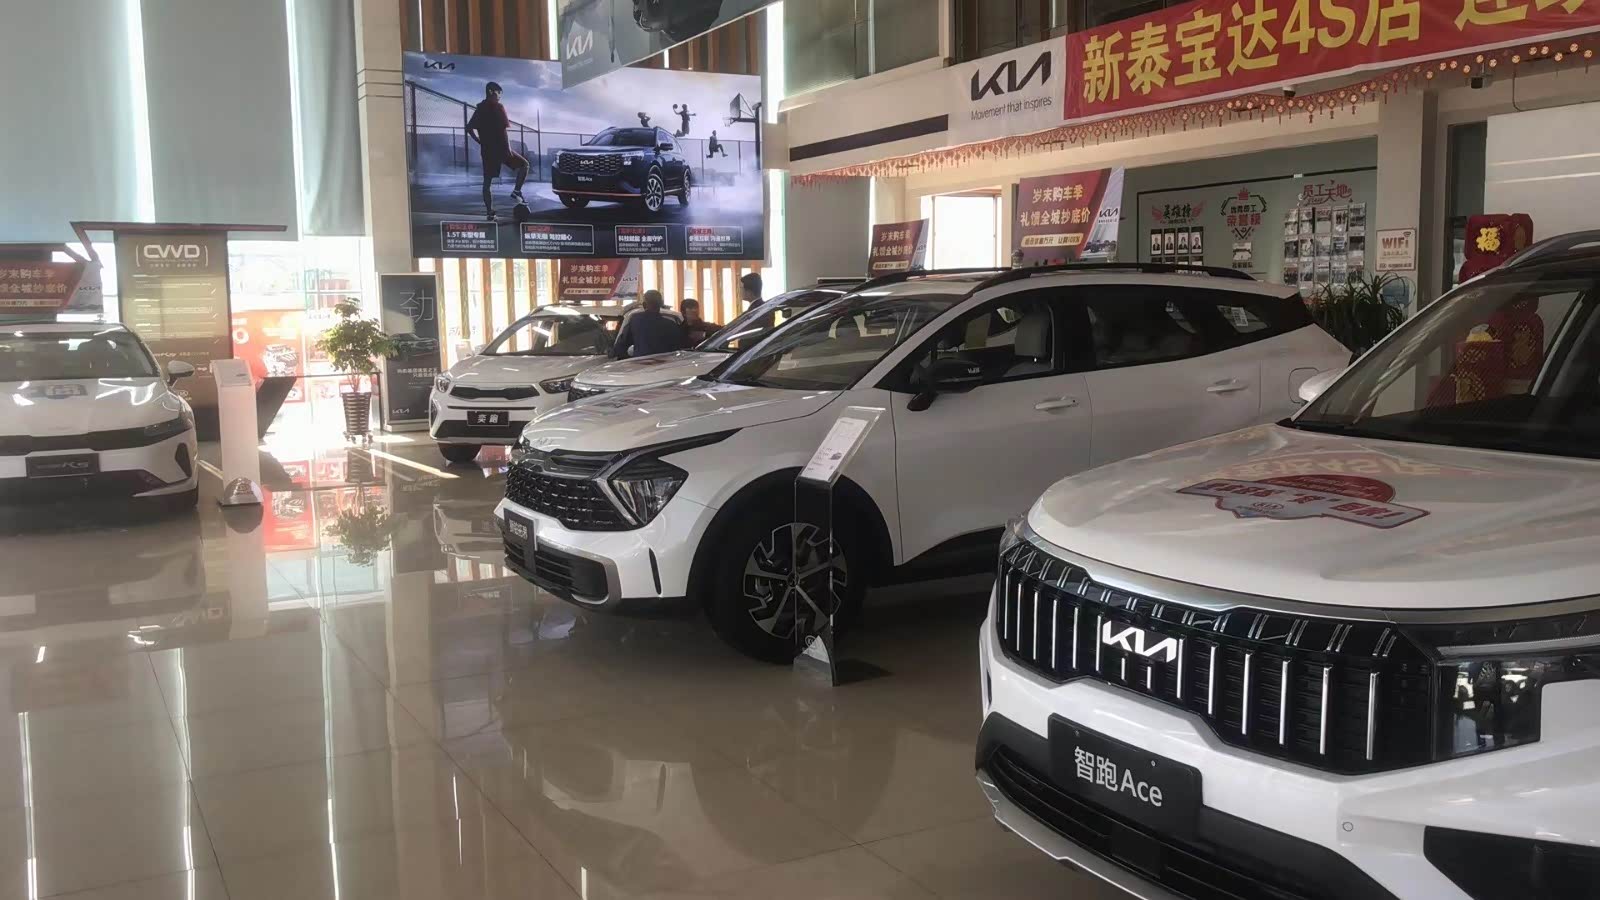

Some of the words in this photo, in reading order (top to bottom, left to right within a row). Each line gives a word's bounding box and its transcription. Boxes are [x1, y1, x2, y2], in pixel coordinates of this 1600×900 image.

[1082, 0, 1421, 104] 新泰宝达4S店
[970, 51, 1052, 101] KIA
[970, 102, 1007, 121] Movement
[1006, 101, 1023, 112] that
[1023, 96, 1053, 112] inspires
[1032, 184, 1084, 203] 岁末购车季
[1303, 181, 1353, 202] 员工天地
[1020, 207, 1091, 227] 礼馈全城抄底价
[1100, 208, 1119, 217] KIA
[143, 244, 200, 259] CVVD
[1476, 227, 1501, 252] 福
[570, 264, 609, 273] 岁末购车季
[399, 289, 434, 322] 劲
[1102, 620, 1178, 663] KIA
[1074, 746, 1163, 807] 智跑Ace
